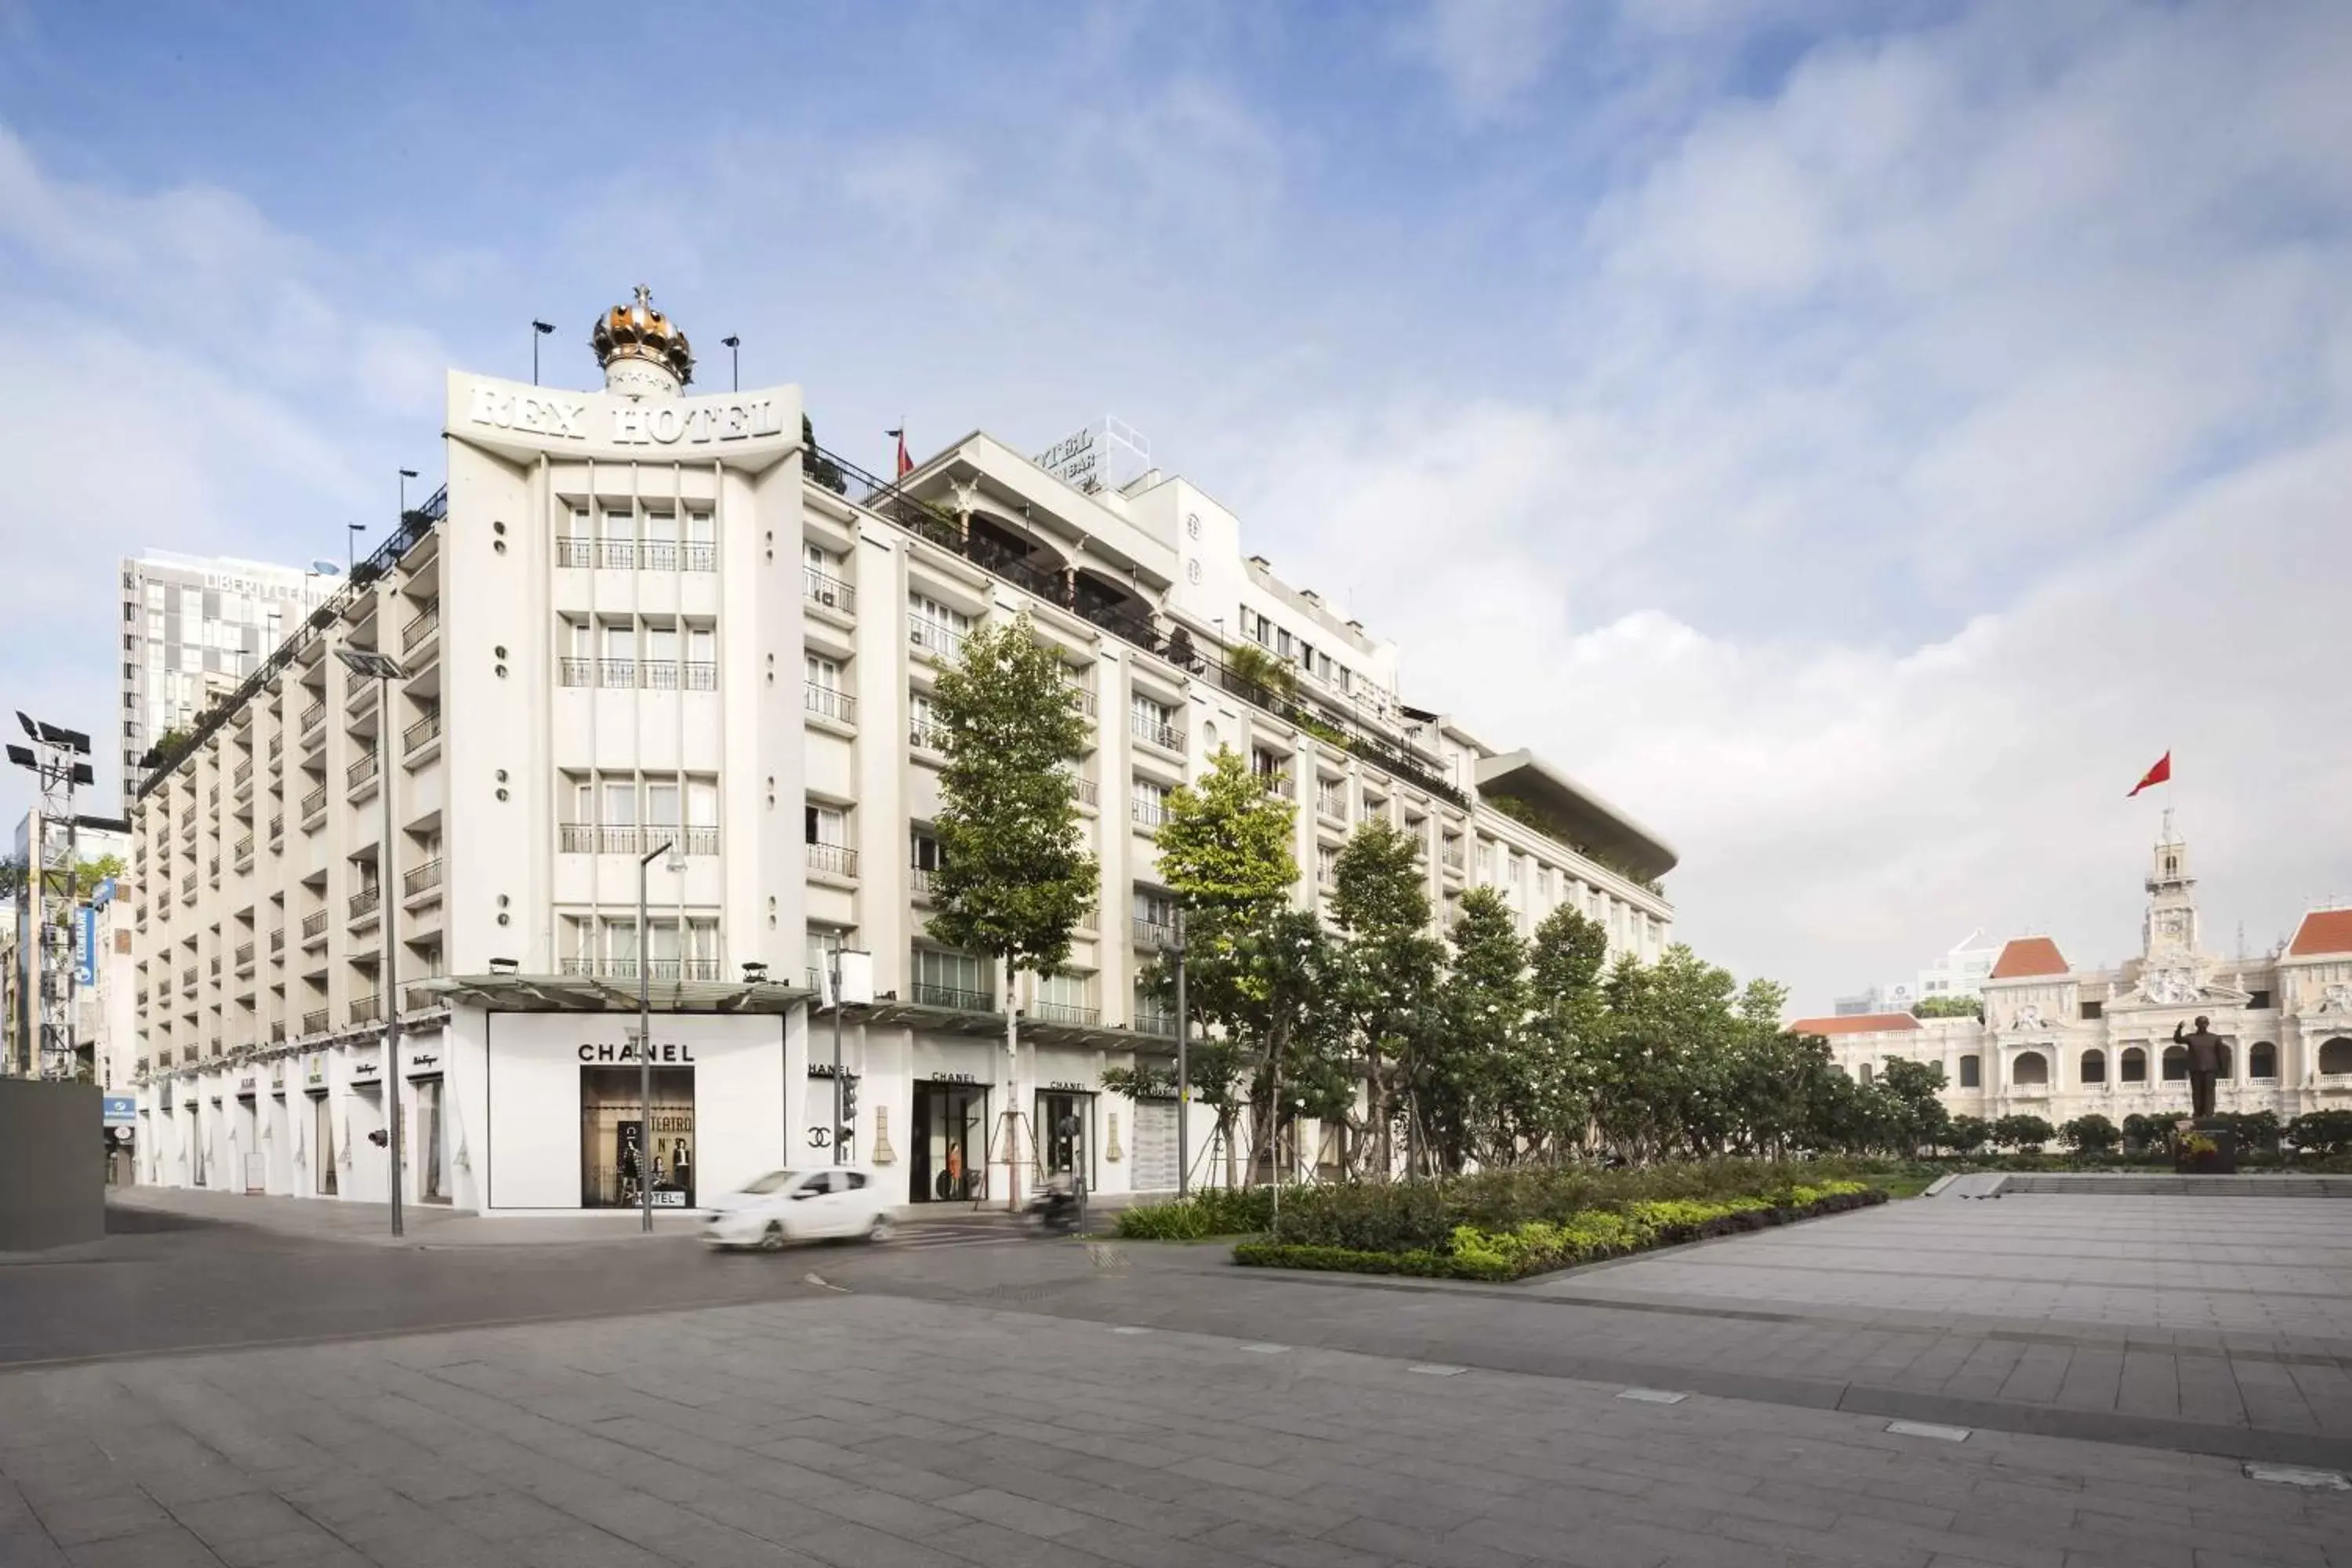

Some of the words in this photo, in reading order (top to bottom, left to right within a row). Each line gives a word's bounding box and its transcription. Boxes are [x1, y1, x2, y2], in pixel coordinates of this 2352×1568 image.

[470, 386, 586, 439] REX
[612, 400, 782, 445] HOTEL
[578, 1043, 695, 1062] CHANEL
[931, 1071, 977, 1083] CHANEL
[1049, 1080, 1087, 1091] CHANEL
[651, 1116, 692, 1133] TEATRO
